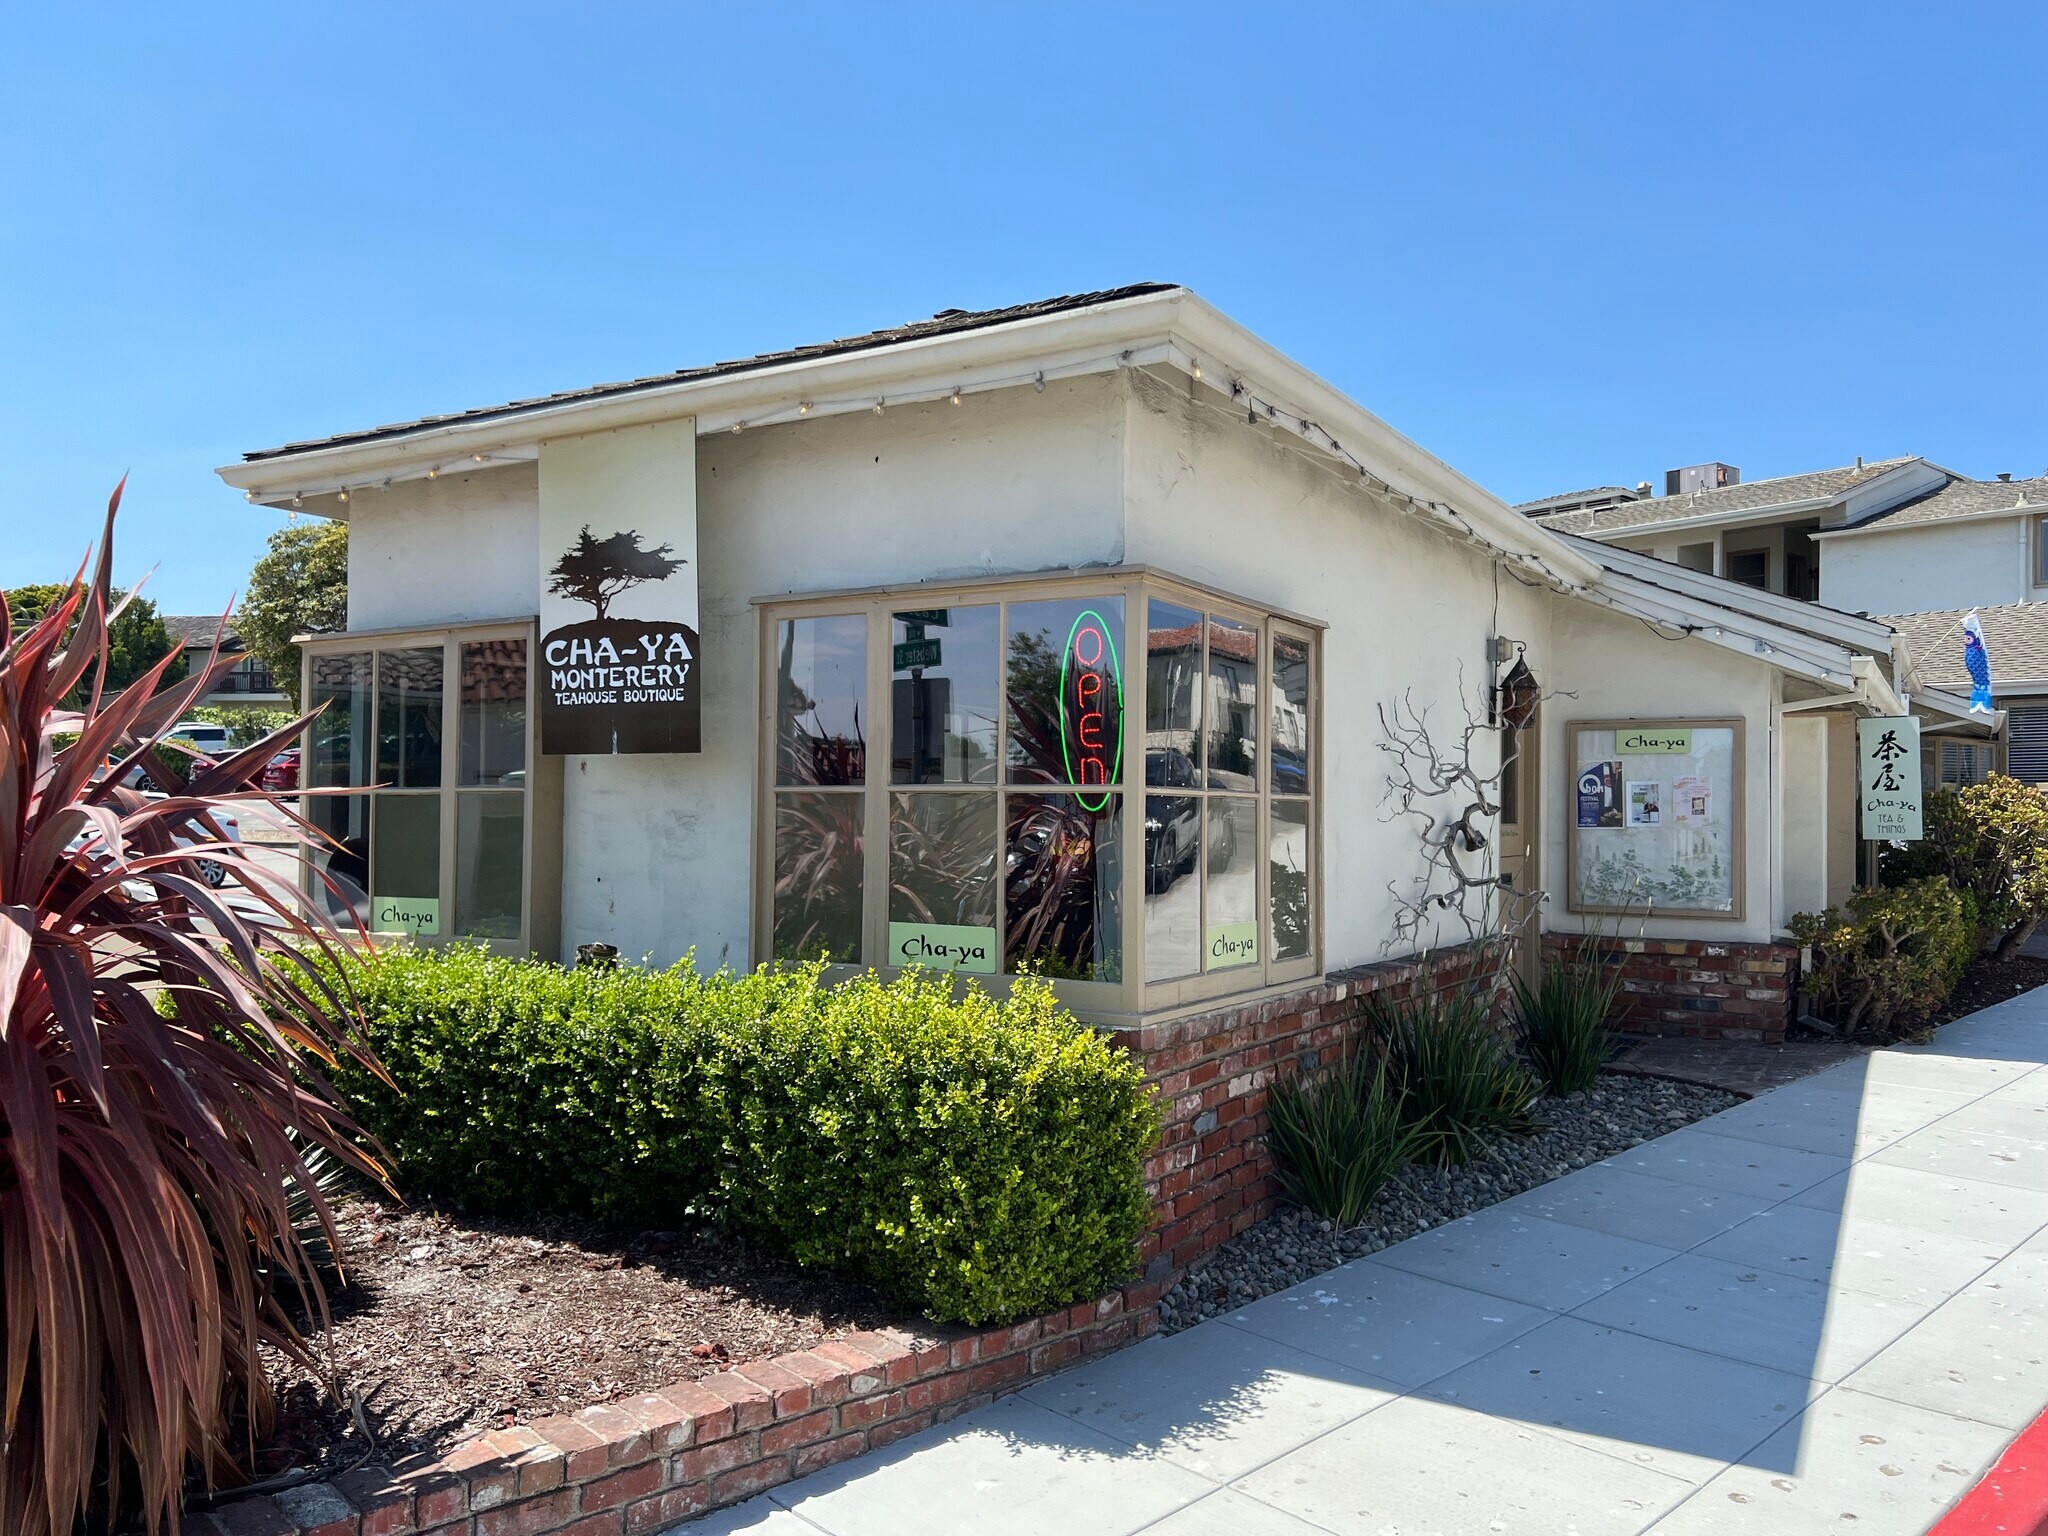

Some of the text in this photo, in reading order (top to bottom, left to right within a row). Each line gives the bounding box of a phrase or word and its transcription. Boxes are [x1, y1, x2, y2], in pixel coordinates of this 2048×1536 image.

[545, 632, 693, 667] CHA-YA
[551, 663, 690, 691] MONTERERY
[555, 688, 685, 706] TEAHOUSE BOUTIQUE
[1625, 735, 1685, 750] Cha-ya
[1871, 730, 1908, 791] 茶屋
[1867, 798, 1916, 812] Cha-ya
[1877, 825, 1906, 834] THINGS
[1878, 814, 1904, 823] TEA &
[381, 905, 433, 928] Cha-ya
[901, 934, 986, 965] Cha-ya
[1212, 934, 1254, 958] Cha-ya
